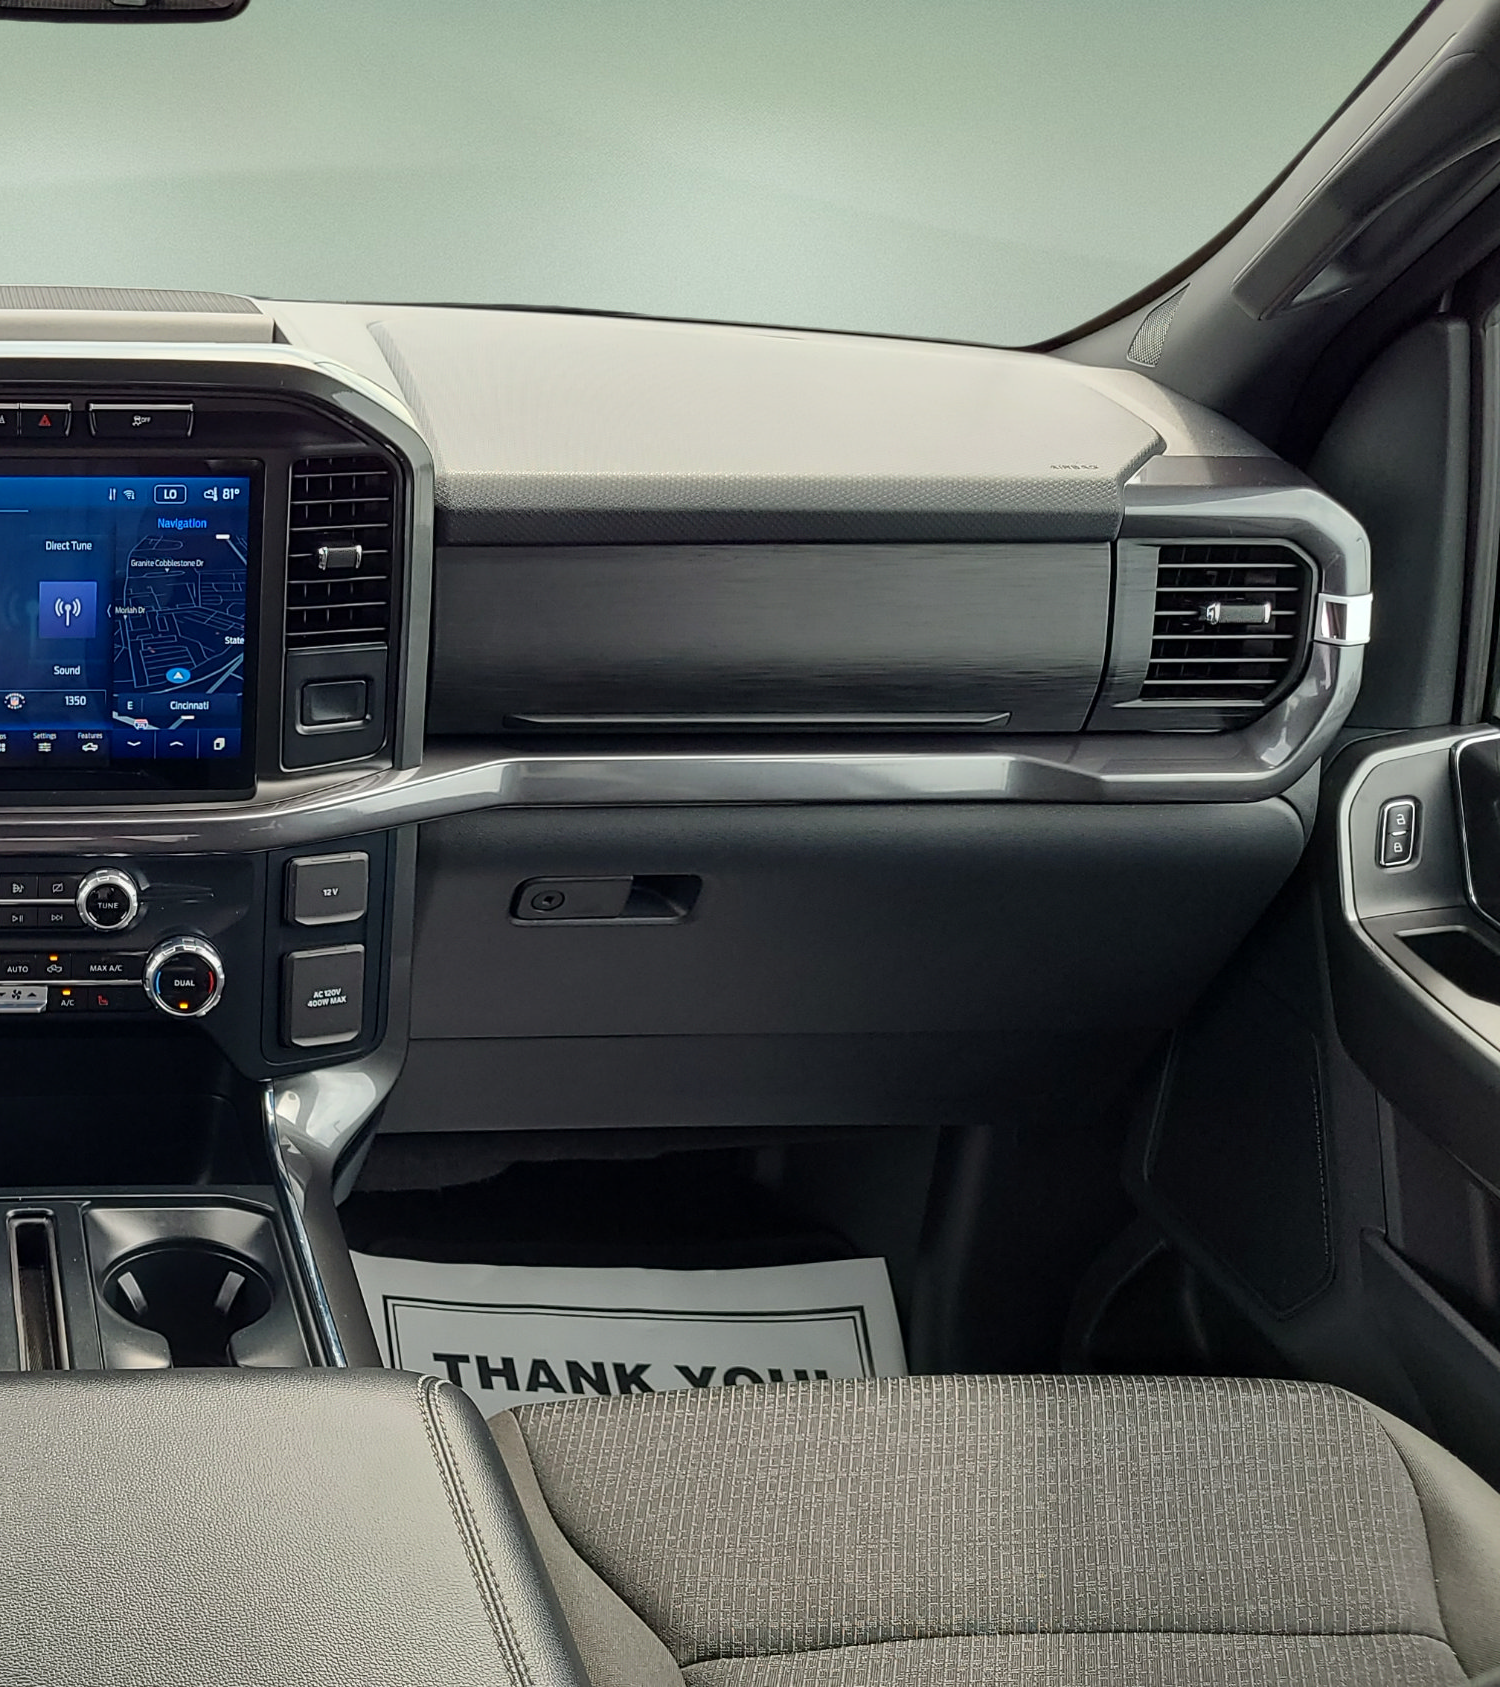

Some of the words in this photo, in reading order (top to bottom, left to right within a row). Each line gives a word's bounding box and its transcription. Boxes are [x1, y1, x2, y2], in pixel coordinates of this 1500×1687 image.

[163, 488, 177, 500] LO
[157, 517, 207, 530] Navigation
[45, 540, 70, 551] Direct
[71, 540, 93, 551] Tune
[130, 559, 155, 567] Granite
[155, 559, 196, 567] Cobblestone
[196, 559, 204, 567] Dr
[138, 606, 146, 614] Dr
[224, 635, 245, 645] State
[53, 665, 81, 675] Sound
[64, 695, 87, 706] 1350
[127, 701, 134, 710] E
[169, 701, 209, 710] Cincinnati
[33, 732, 57, 741] Settings
[77, 732, 103, 740] Features
[322, 888, 332, 897] 12
[108, 964, 123, 972] A/C
[174, 979, 196, 987] DUAL
[313, 990, 324, 999] AC
[324, 987, 342, 997] 120V
[307, 998, 330, 1008] 400W
[330, 995, 347, 1005] MAX
[432, 1352, 655, 1395] THANK
